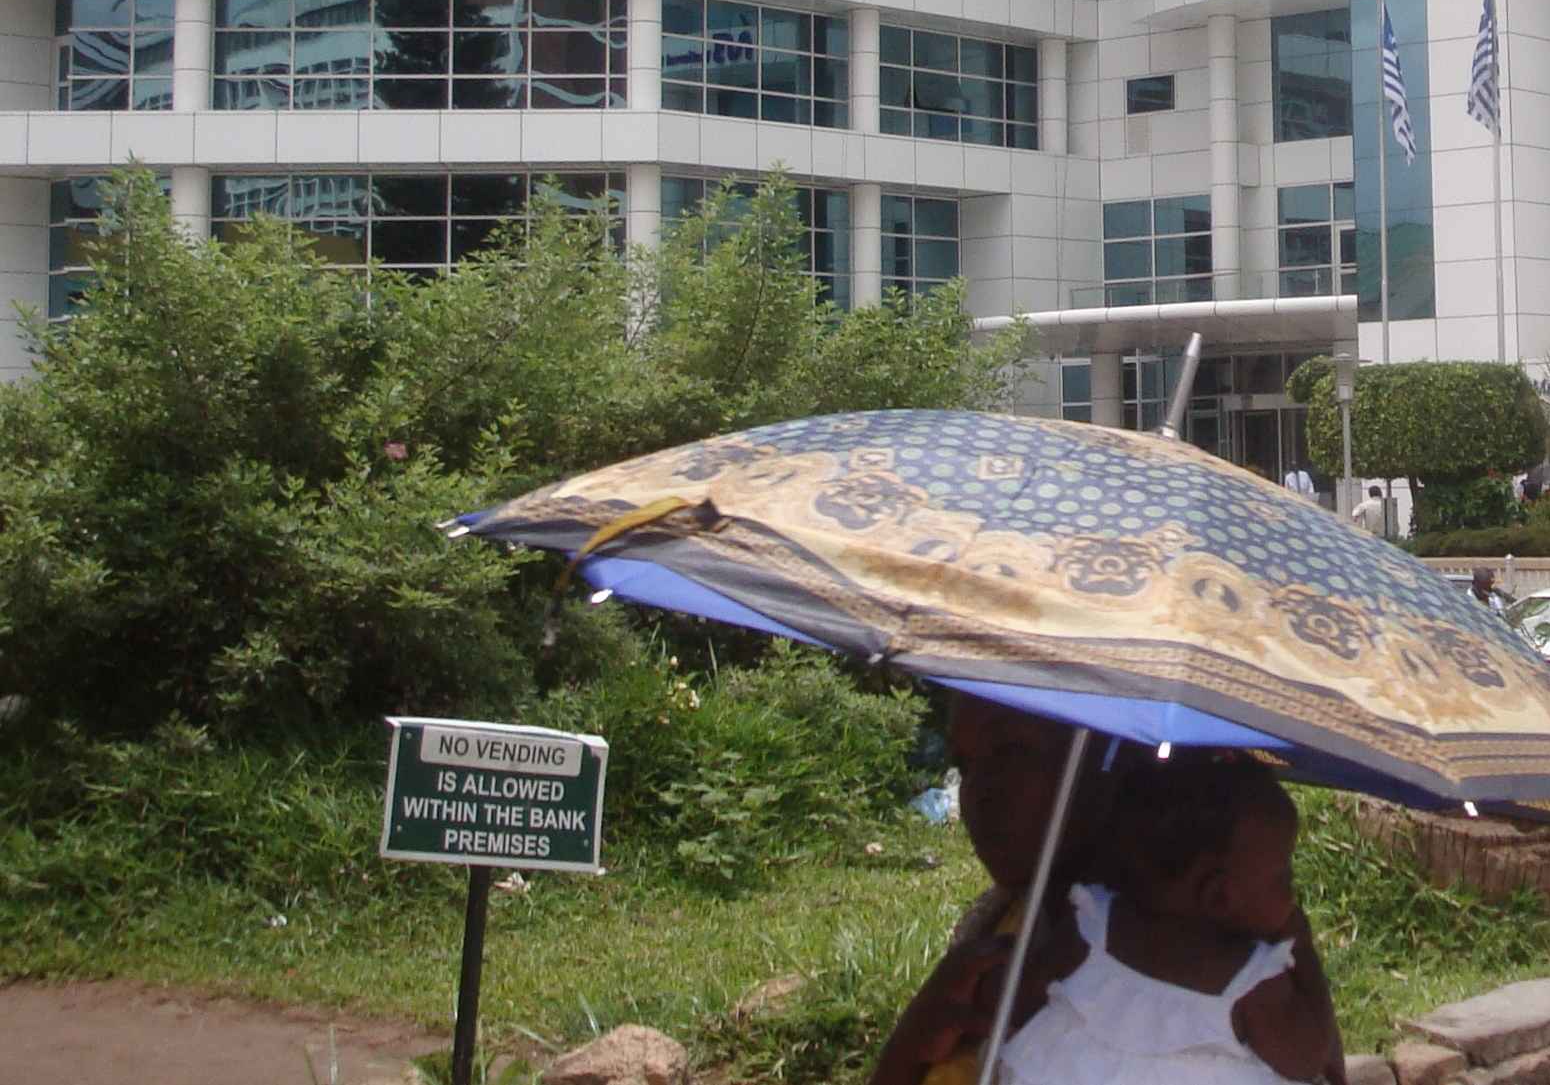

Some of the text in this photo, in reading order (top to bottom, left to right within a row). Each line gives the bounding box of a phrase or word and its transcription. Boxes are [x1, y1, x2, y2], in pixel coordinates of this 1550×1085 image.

[438, 735, 566, 765] NO VENDING
[437, 771, 565, 802] IS ALLOWED
[403, 796, 586, 831] WITHIN THE BANK
[444, 829, 551, 857] PREMISES
